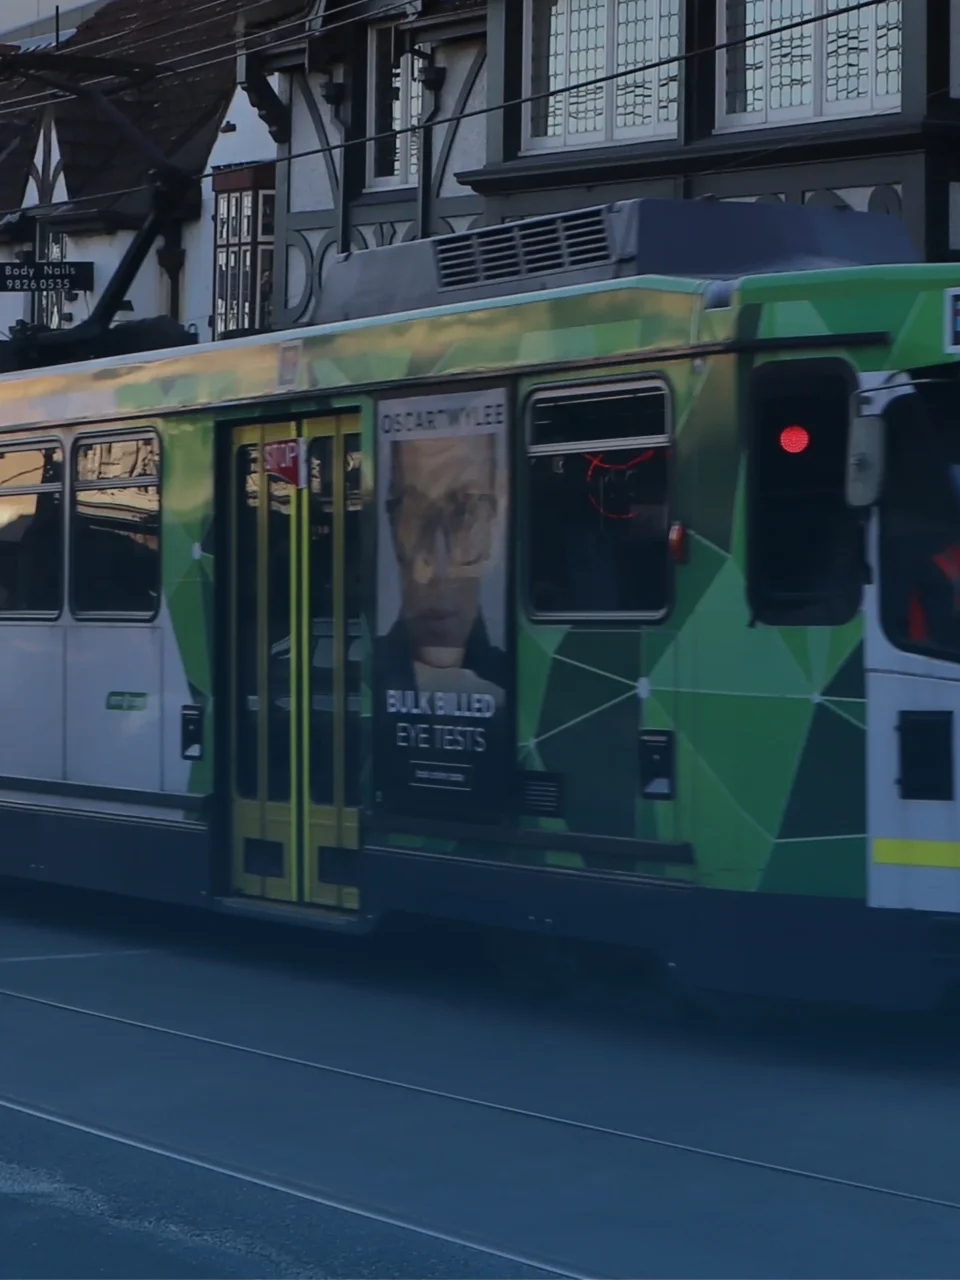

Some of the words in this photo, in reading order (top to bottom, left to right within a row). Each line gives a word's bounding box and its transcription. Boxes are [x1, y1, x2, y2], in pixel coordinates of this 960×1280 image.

[5, 265, 35, 277] Body
[44, 265, 76, 275] Nails
[6, 279, 37, 289] 9826
[40, 279, 70, 289] 0535
[386, 689, 432, 715] BULK
[396, 722, 430, 748] EYE
[432, 724, 488, 752] TESTS
